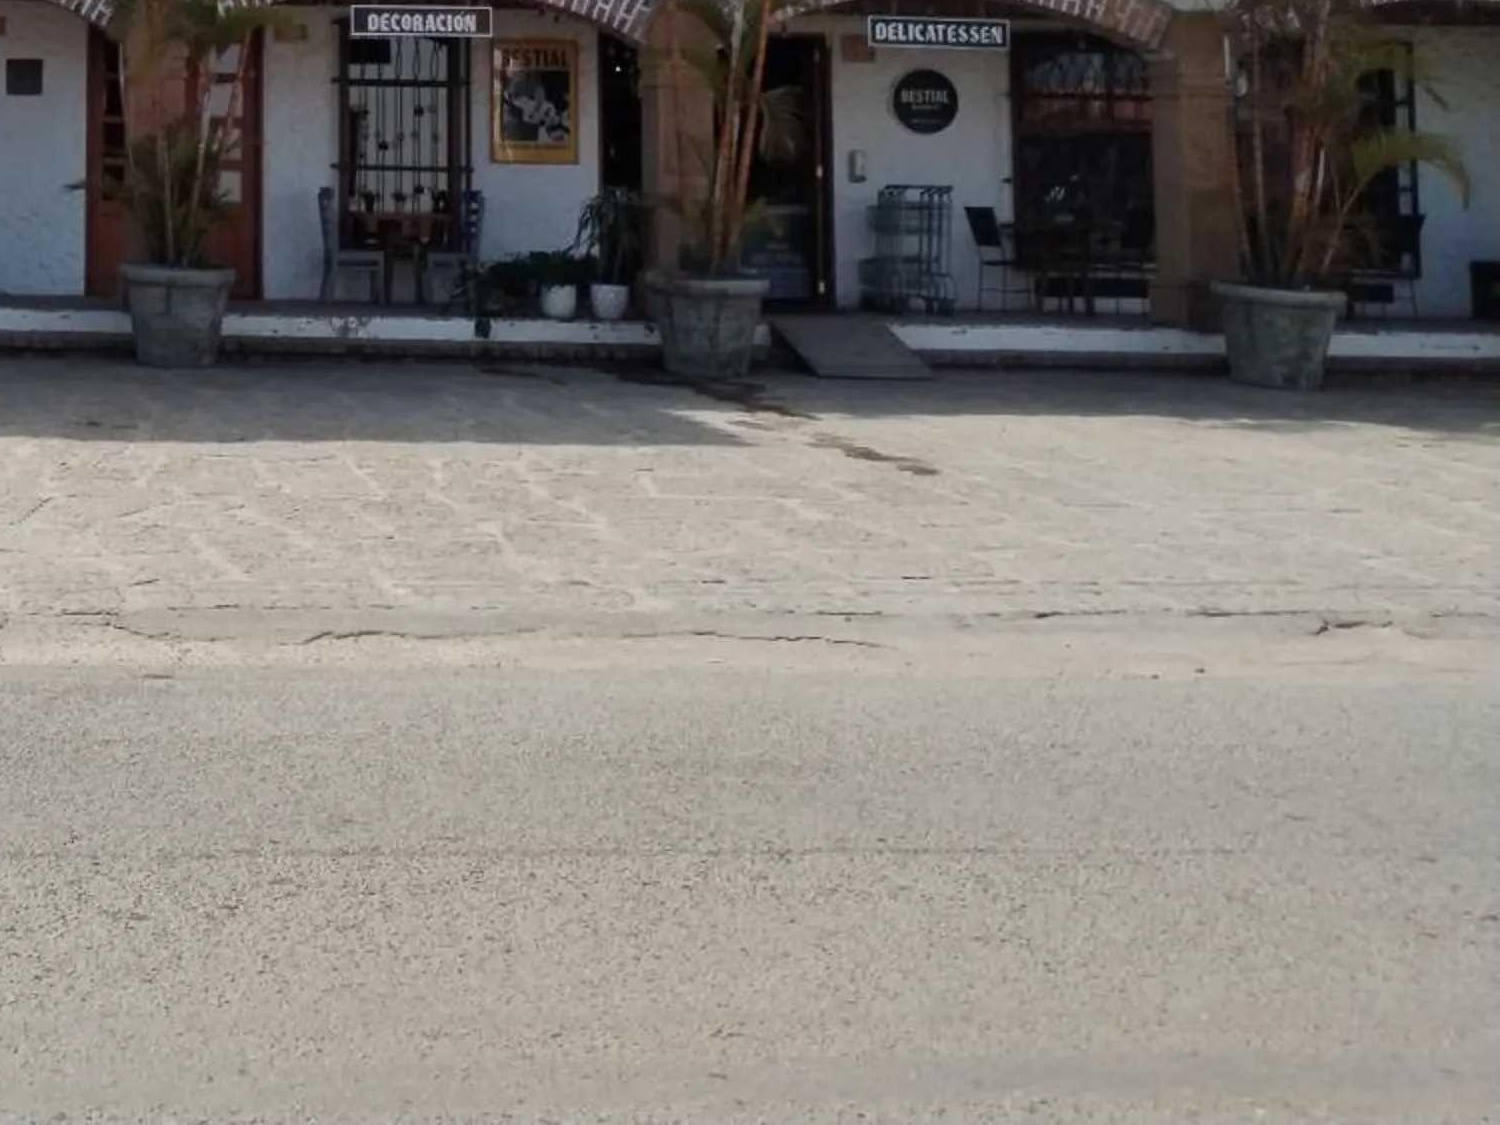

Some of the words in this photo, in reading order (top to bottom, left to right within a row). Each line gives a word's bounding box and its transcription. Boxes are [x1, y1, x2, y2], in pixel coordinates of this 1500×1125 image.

[367, 11, 477, 32] DECORACIÓN
[875, 22, 1003, 44] DELICATESSEN
[901, 89, 949, 104] BESTIAL
